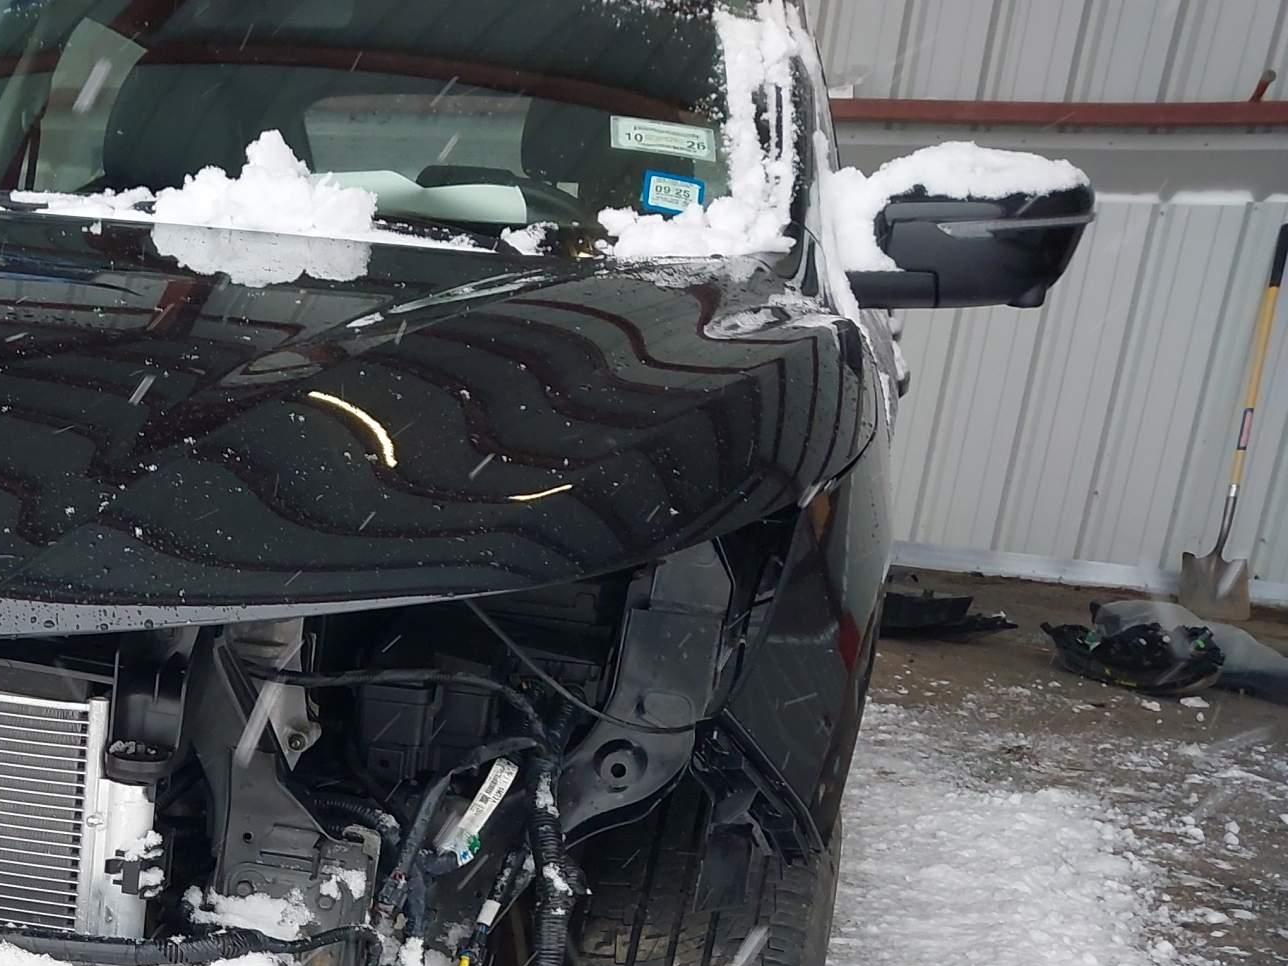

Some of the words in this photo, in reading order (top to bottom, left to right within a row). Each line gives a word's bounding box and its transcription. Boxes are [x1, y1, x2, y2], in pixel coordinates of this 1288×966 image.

[625, 132, 643, 143] 10
[686, 140, 706, 151] 26
[655, 185, 671, 194] 09
[675, 188, 690, 198] 25
